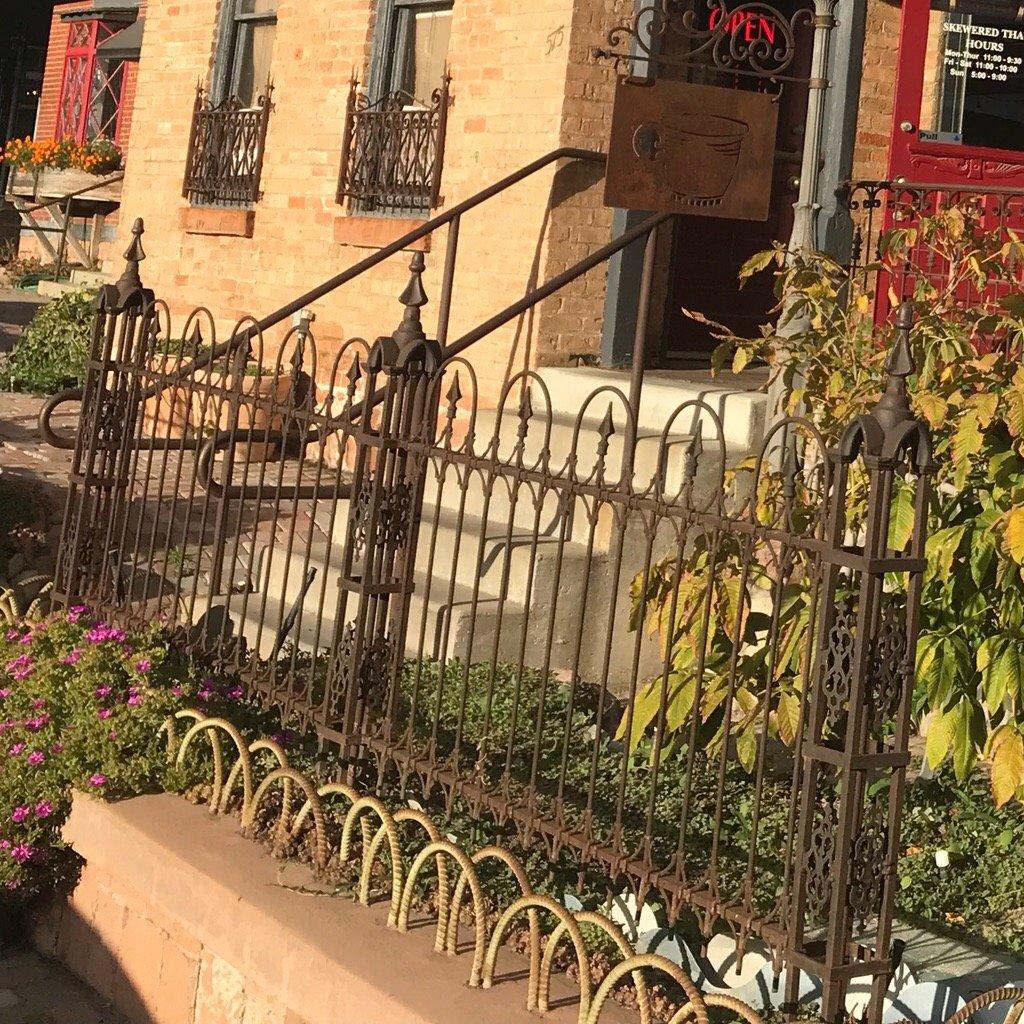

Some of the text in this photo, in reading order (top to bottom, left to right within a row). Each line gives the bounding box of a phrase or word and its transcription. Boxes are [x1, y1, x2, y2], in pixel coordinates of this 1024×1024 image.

[709, 7, 776, 45] OPEN
[942, 22, 1000, 37] SKEWERED
[965, 39, 1004, 52] HOURS
[944, 49, 980, 59] Mon-Thur
[983, 53, 1002, 62] 11:00
[1006, 57, 1022, 65] 9:30
[943, 57, 954, 65] Fri
[959, 60, 972, 68] Sat
[975, 61, 994, 70] 11:00
[999, 64, 1018, 73] 10:00
[949, 68, 965, 77] Sun
[970, 70, 986, 79] 5:00
[991, 73, 1007, 82] 9:00
[919, 132, 938, 140] Pull
